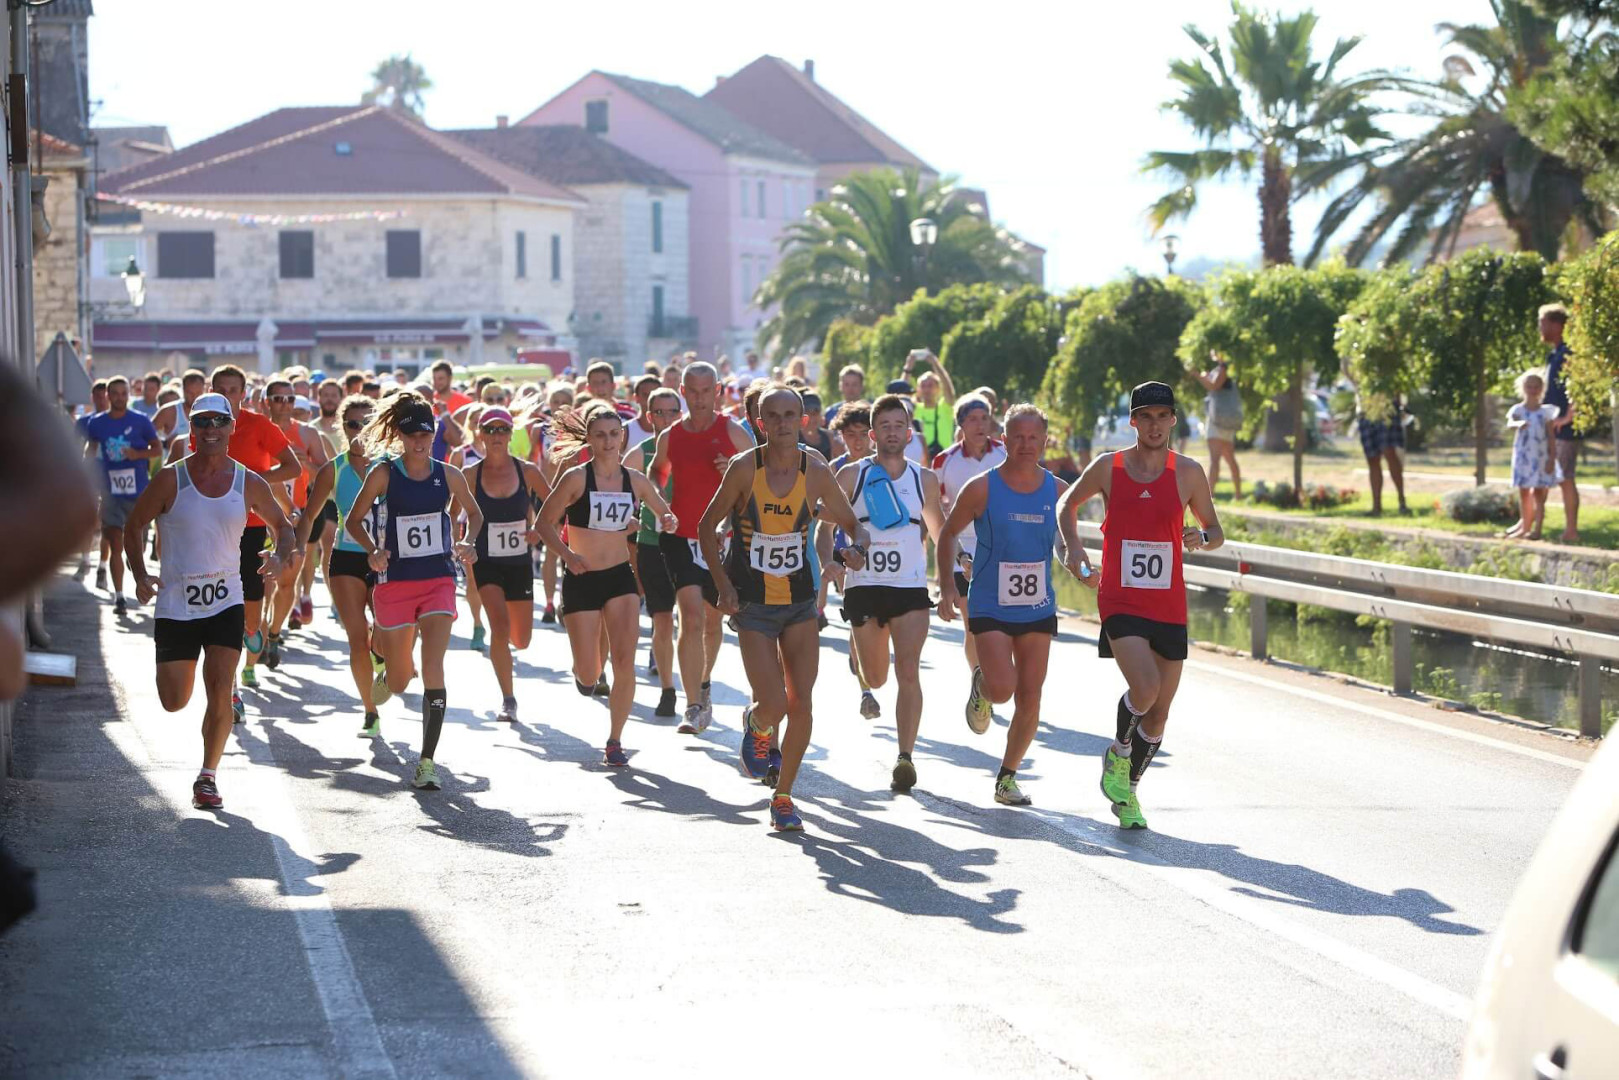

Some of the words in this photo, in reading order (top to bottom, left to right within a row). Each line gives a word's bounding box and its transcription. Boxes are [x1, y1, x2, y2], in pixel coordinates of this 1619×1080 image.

[113, 475, 134, 489] 102
[593, 502, 631, 523] 147
[763, 503, 793, 516] FILA
[407, 524, 432, 549] 61
[497, 530, 520, 550] 16
[754, 545, 799, 570] 155
[1131, 553, 1163, 579] 50
[186, 578, 229, 606] 206
[1008, 573, 1038, 597] 38
